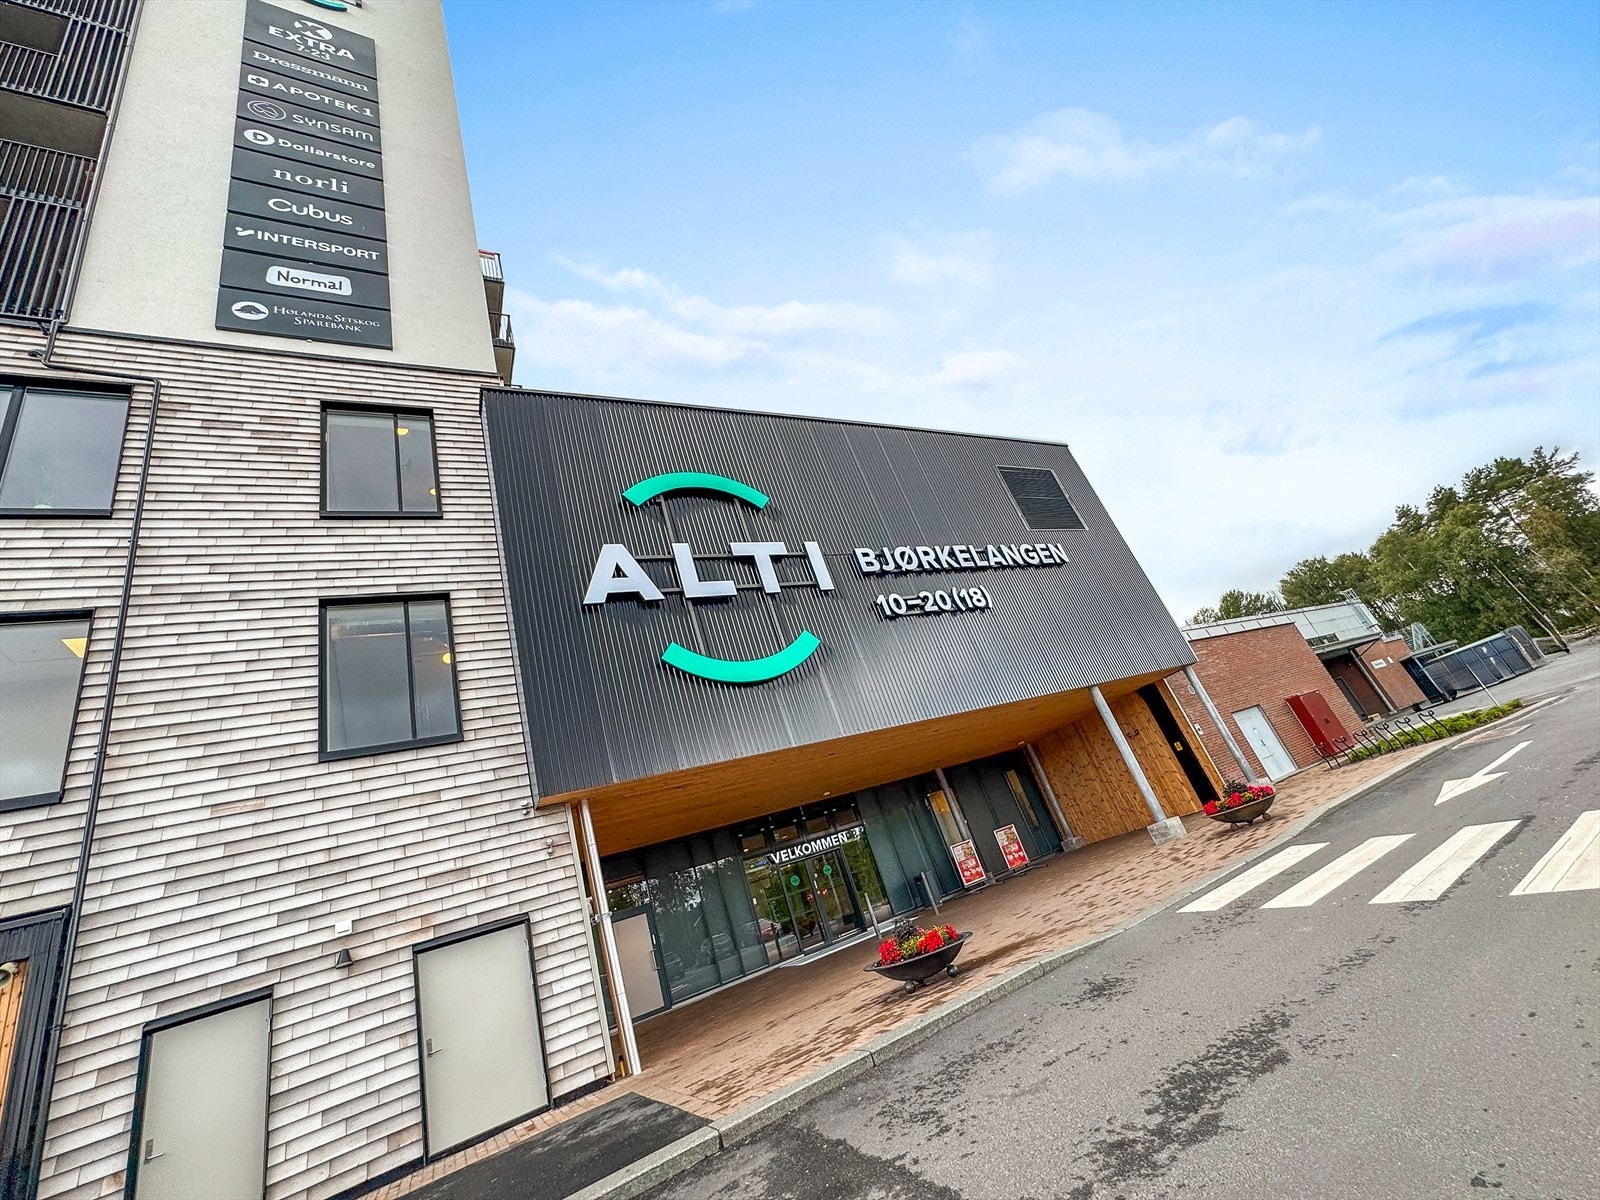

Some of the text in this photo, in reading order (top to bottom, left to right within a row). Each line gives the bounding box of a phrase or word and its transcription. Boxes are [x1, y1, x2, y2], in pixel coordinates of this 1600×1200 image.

[268, 25, 356, 61] EXTRA
[296, 43, 331, 61] 7-23
[252, 50, 369, 92] Dressmann
[272, 82, 362, 114] APOTEK
[292, 114, 374, 142] SYNSAM
[278, 138, 376, 169] Dollarstore
[273, 168, 350, 194] norli
[267, 198, 354, 226] Cubus
[257, 230, 380, 261] INTERSPORT
[277, 270, 343, 292] Normal
[294, 316, 363, 333] SPAREBANK
[583, 541, 1069, 605] ALTI BJØRKELANGEN
[770, 832, 848, 864] VELKOMMEN
